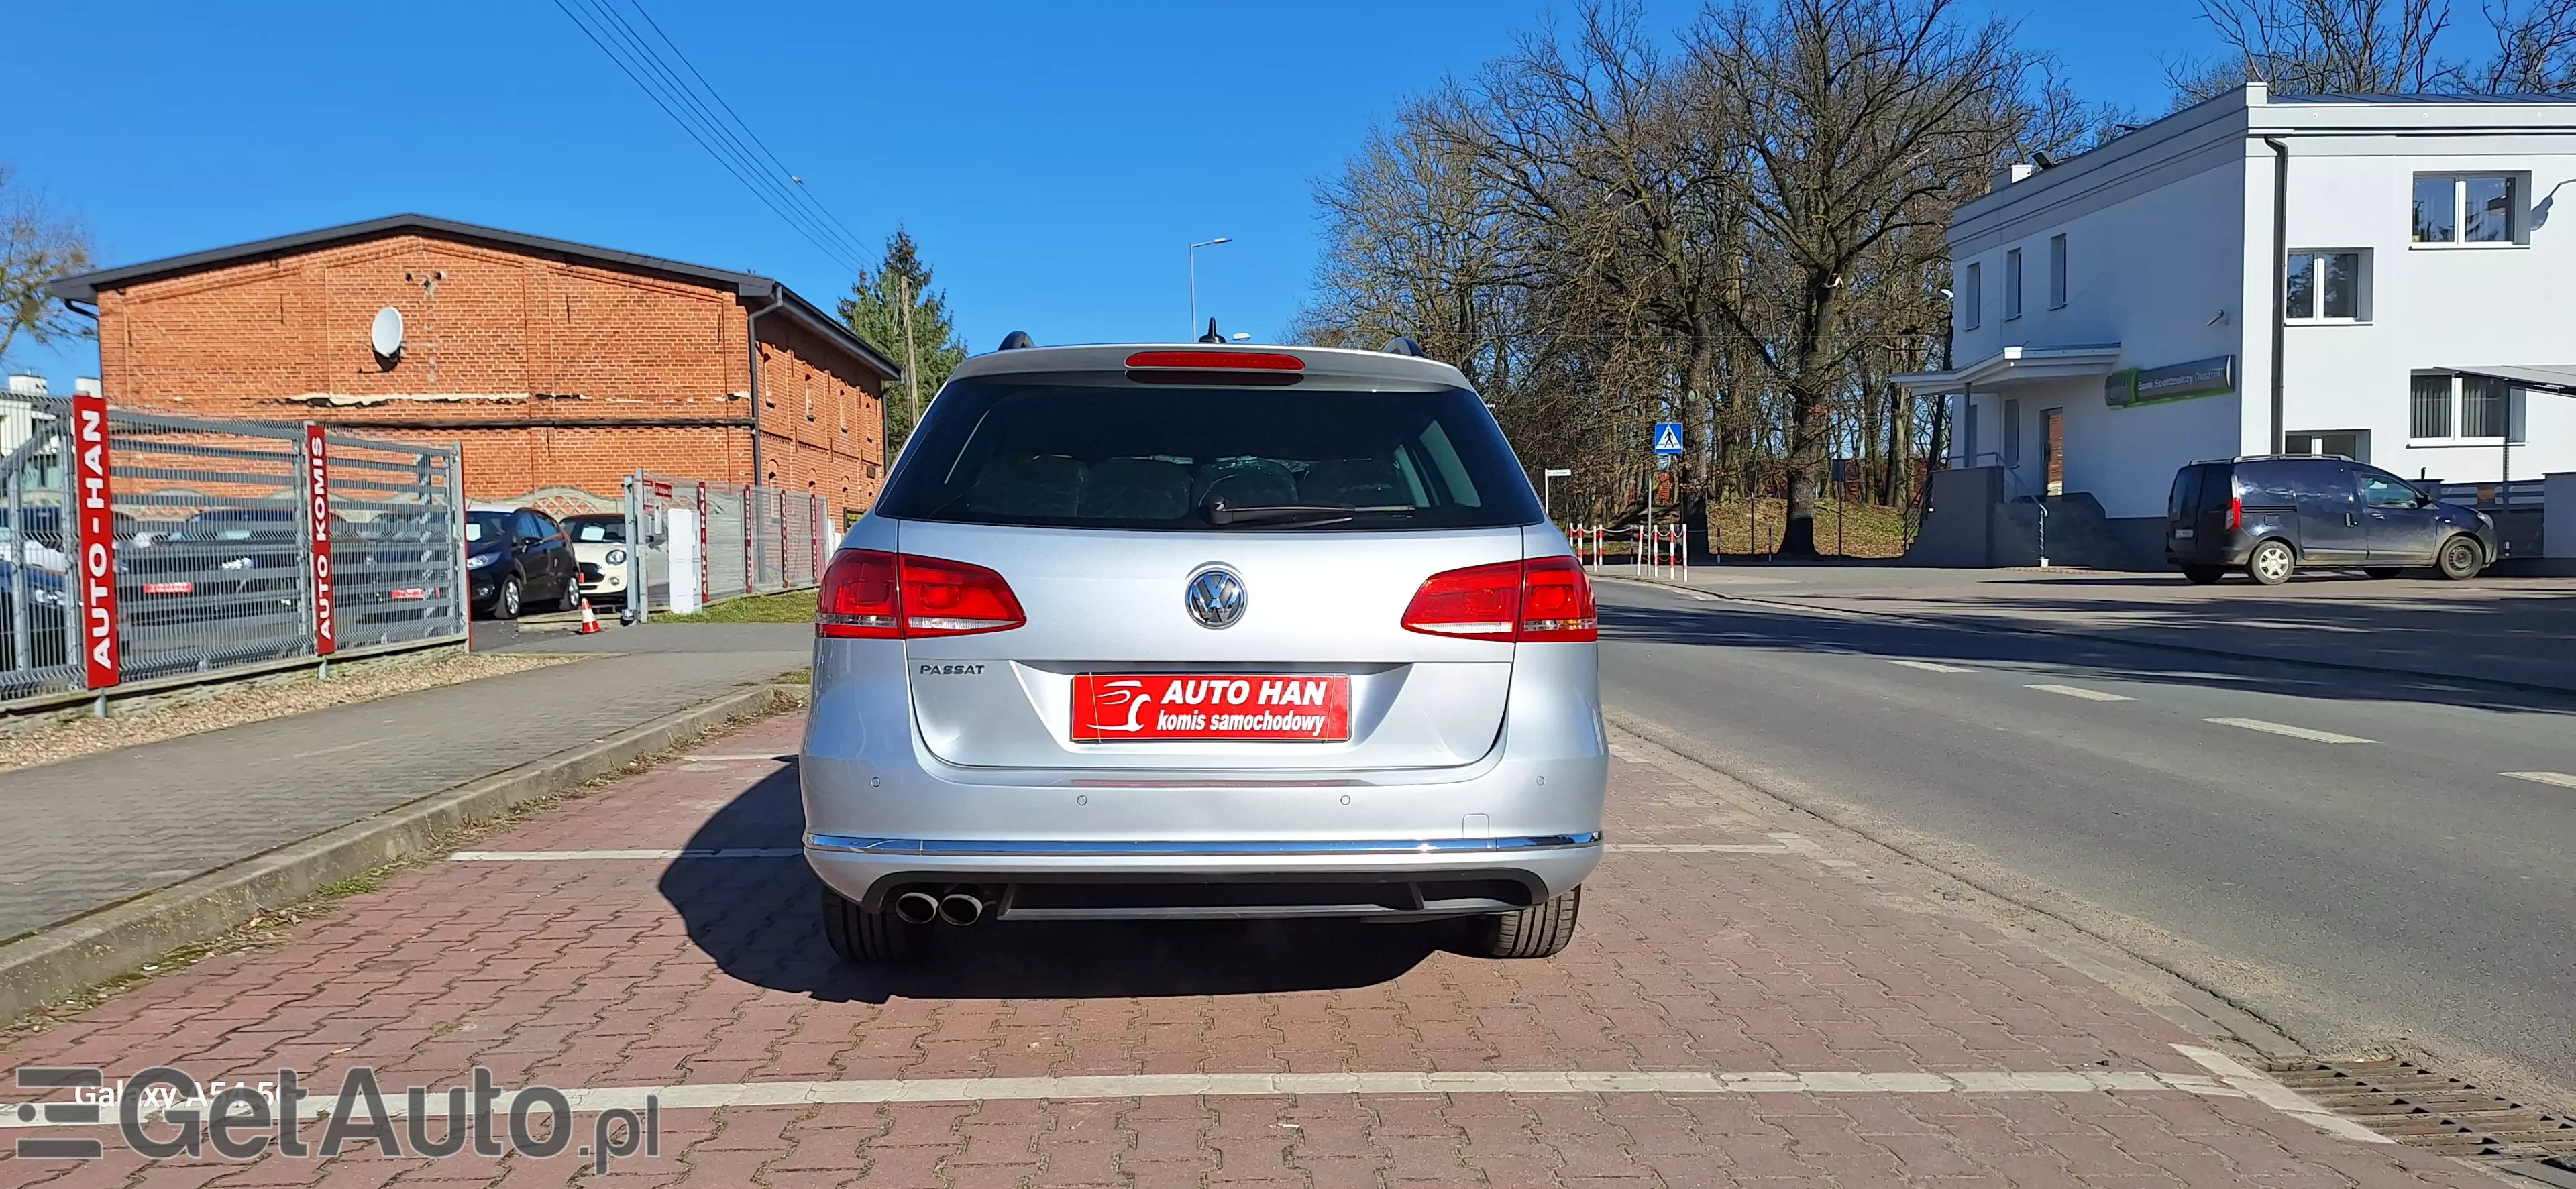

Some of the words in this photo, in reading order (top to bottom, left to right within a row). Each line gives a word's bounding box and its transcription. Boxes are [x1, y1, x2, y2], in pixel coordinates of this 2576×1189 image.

[311, 436, 327, 541] KOMIS
[317, 554, 331, 640] AUTO
[920, 665, 985, 675] PASSAT
[1161, 679, 1250, 705] AUTO
[1258, 680, 1328, 705] HAN
[1157, 709, 1206, 730] komis
[1210, 709, 1325, 736] samochodowy
